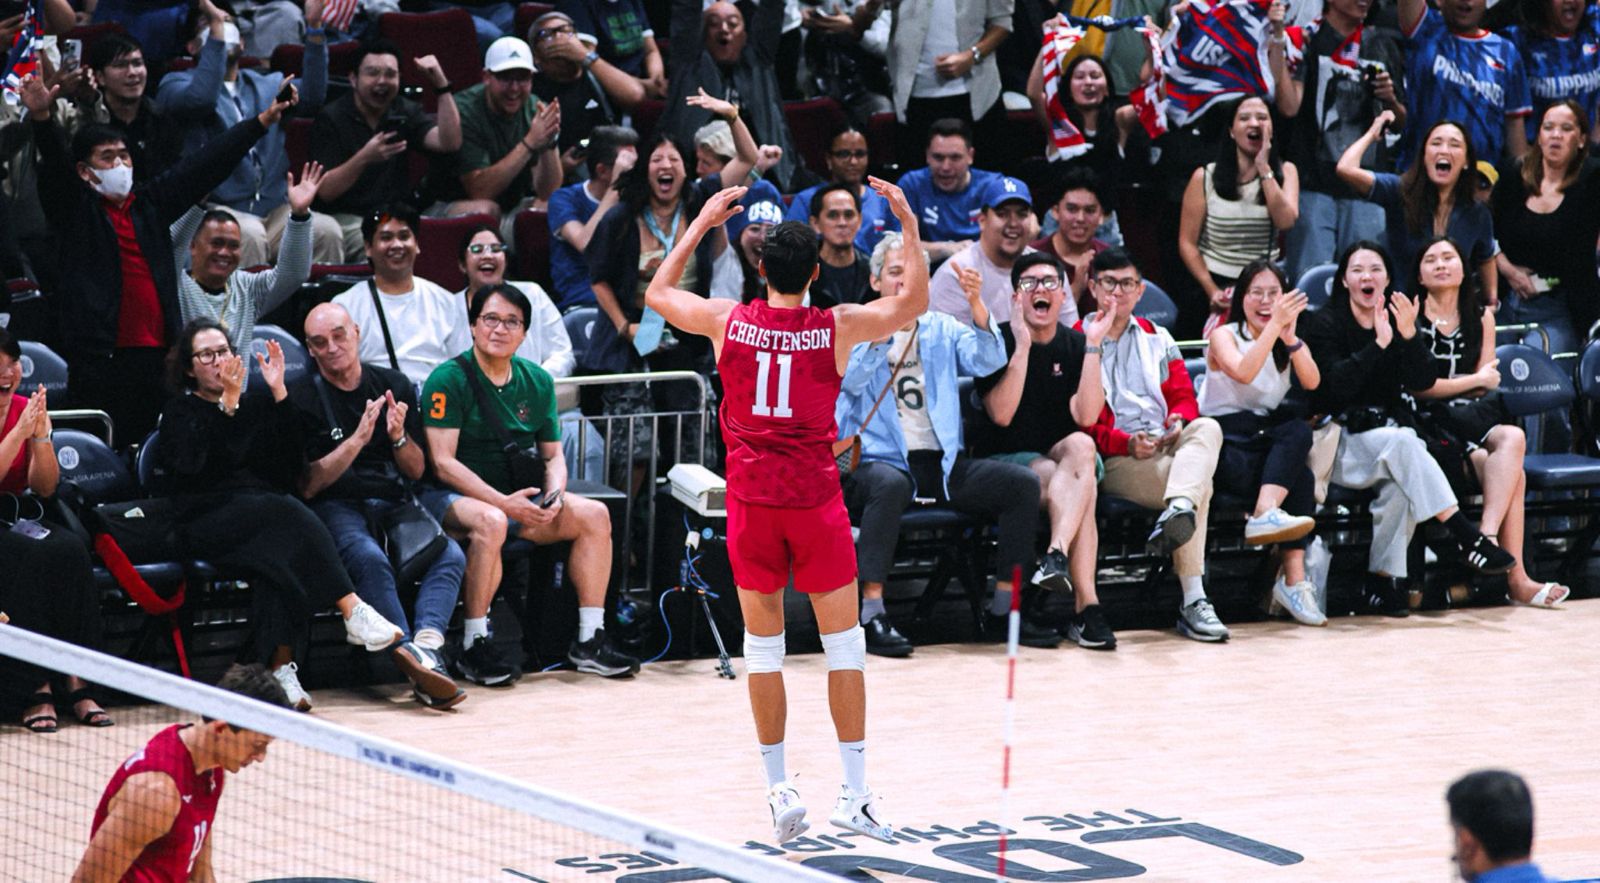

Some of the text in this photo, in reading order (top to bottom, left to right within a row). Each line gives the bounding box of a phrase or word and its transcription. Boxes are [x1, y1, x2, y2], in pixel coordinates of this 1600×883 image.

[748, 200, 783, 225] USA
[727, 319, 832, 351] CHRISTENSON
[751, 350, 793, 418] 11
[430, 392, 447, 420] 3
[1023, 808, 1182, 833] THE
